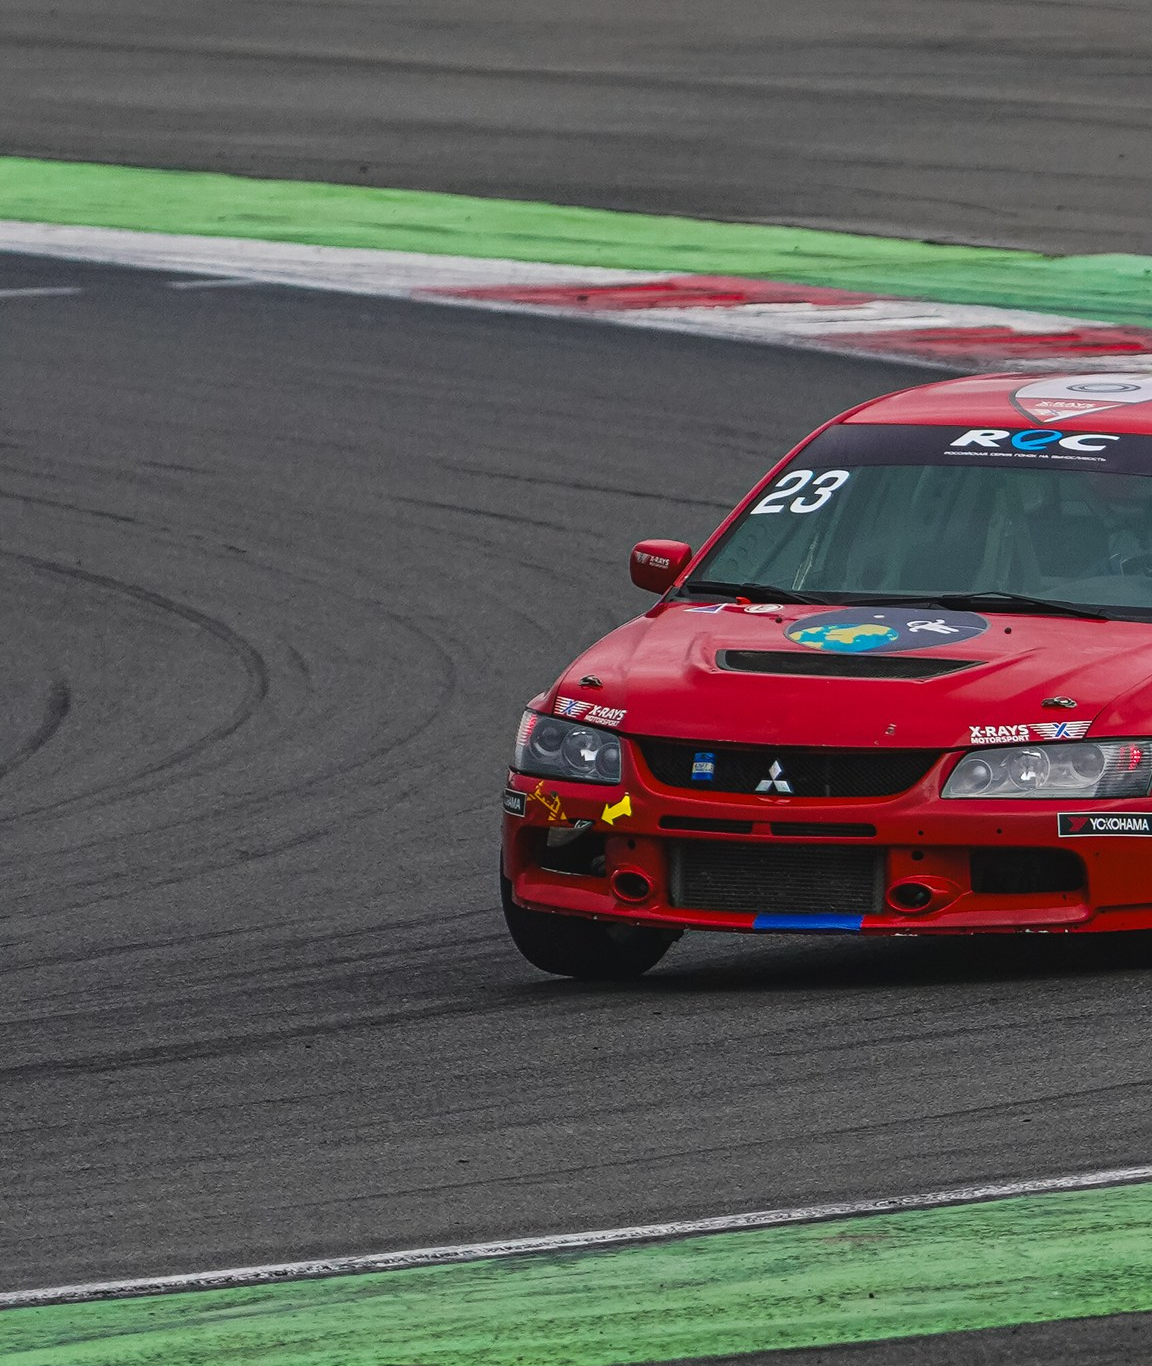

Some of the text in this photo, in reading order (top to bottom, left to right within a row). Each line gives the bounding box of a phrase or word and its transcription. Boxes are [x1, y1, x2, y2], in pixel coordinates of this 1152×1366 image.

[750, 470, 850, 515] 23
[588, 704, 628, 721] X-RAYS
[583, 714, 620, 727] MOTORSPORT
[969, 724, 1029, 737] X-RAYS
[970, 734, 1030, 745] MOTORSPORT
[1089, 817, 1150, 831] YOKOHAMA
